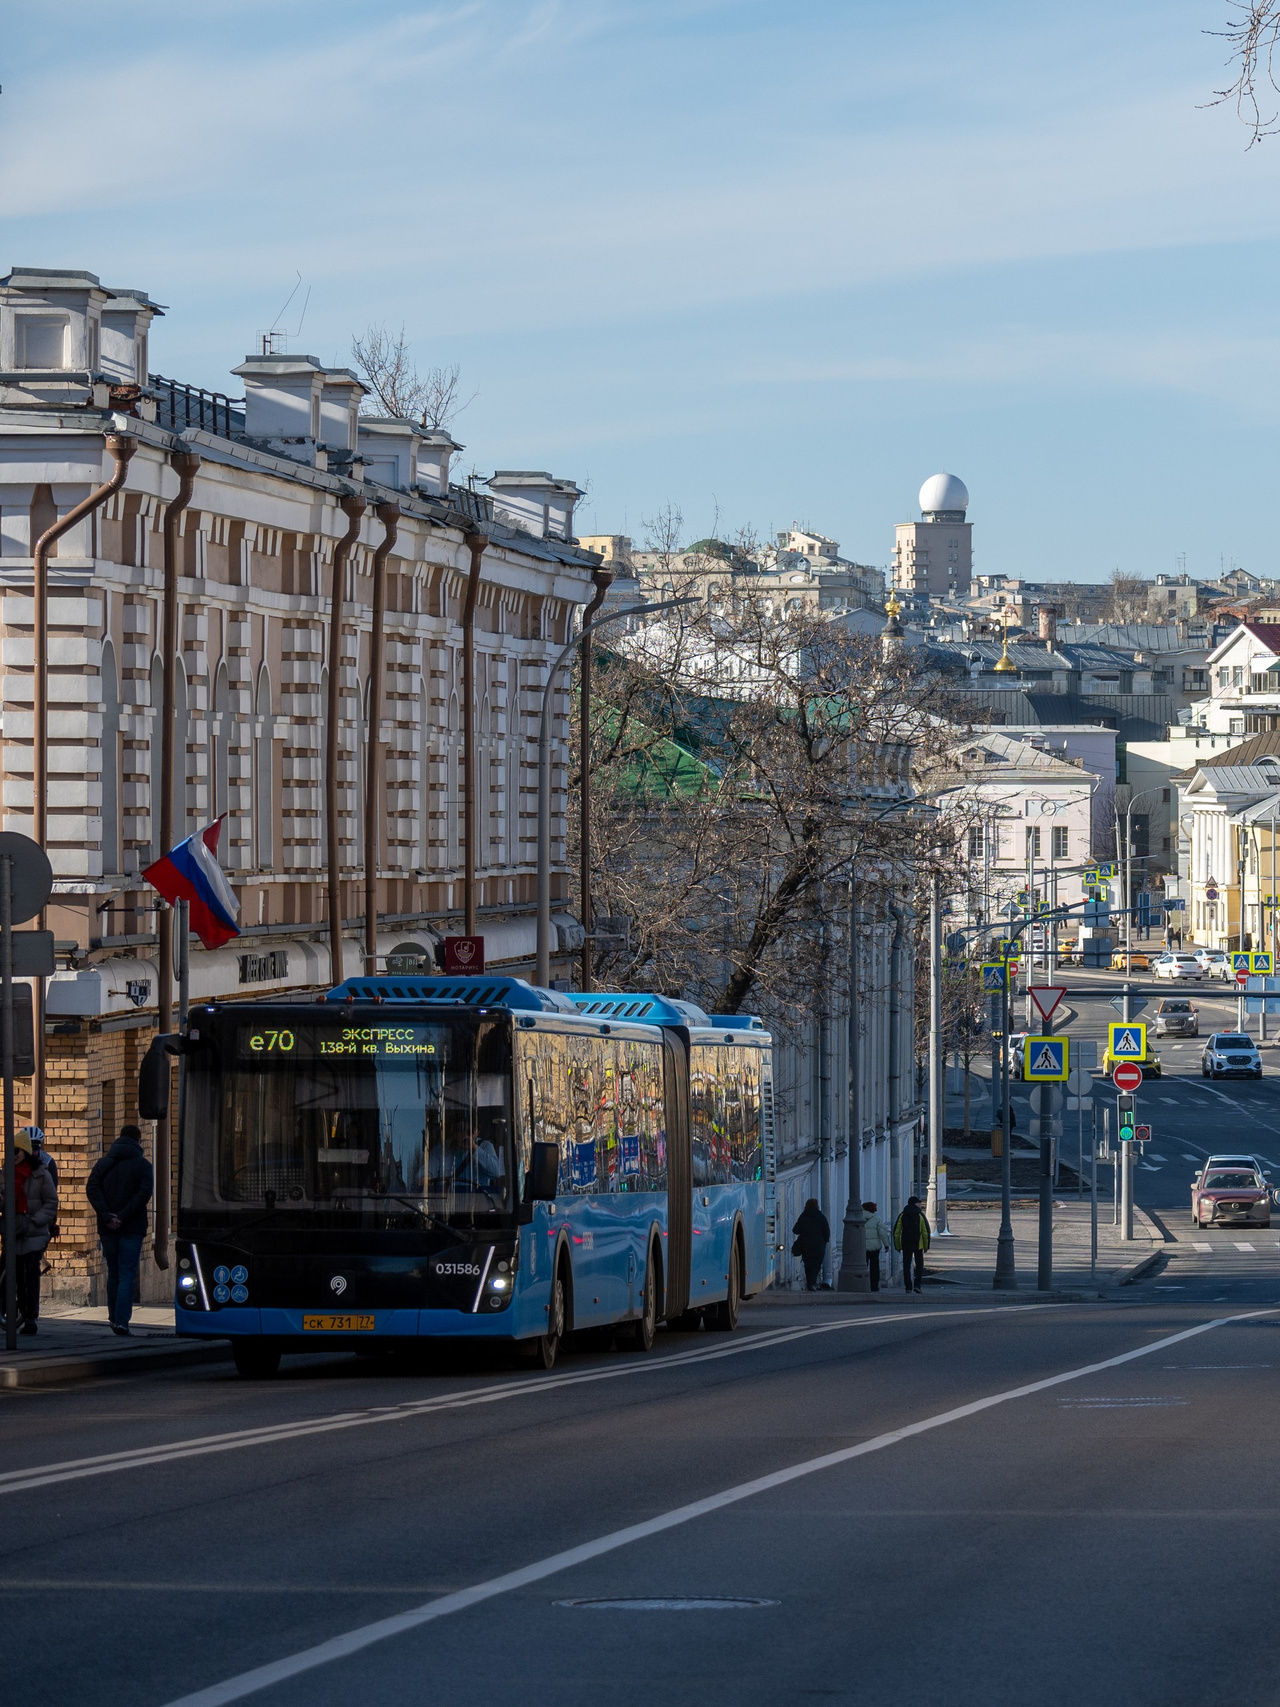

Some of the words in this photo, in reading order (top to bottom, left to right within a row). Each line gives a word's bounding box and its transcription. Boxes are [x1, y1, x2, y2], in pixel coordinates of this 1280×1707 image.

[342, 1028, 414, 1040] ЭКСПРЕСС
[320, 1041, 357, 1053] 138-й
[363, 1043, 380, 1053] кв.
[386, 1042, 435, 1053] Выхина
[436, 1263, 480, 1275] 031586
[309, 1319, 324, 1329] СК
[330, 1316, 351, 1329] 731
[359, 1316, 371, 1326] 77
